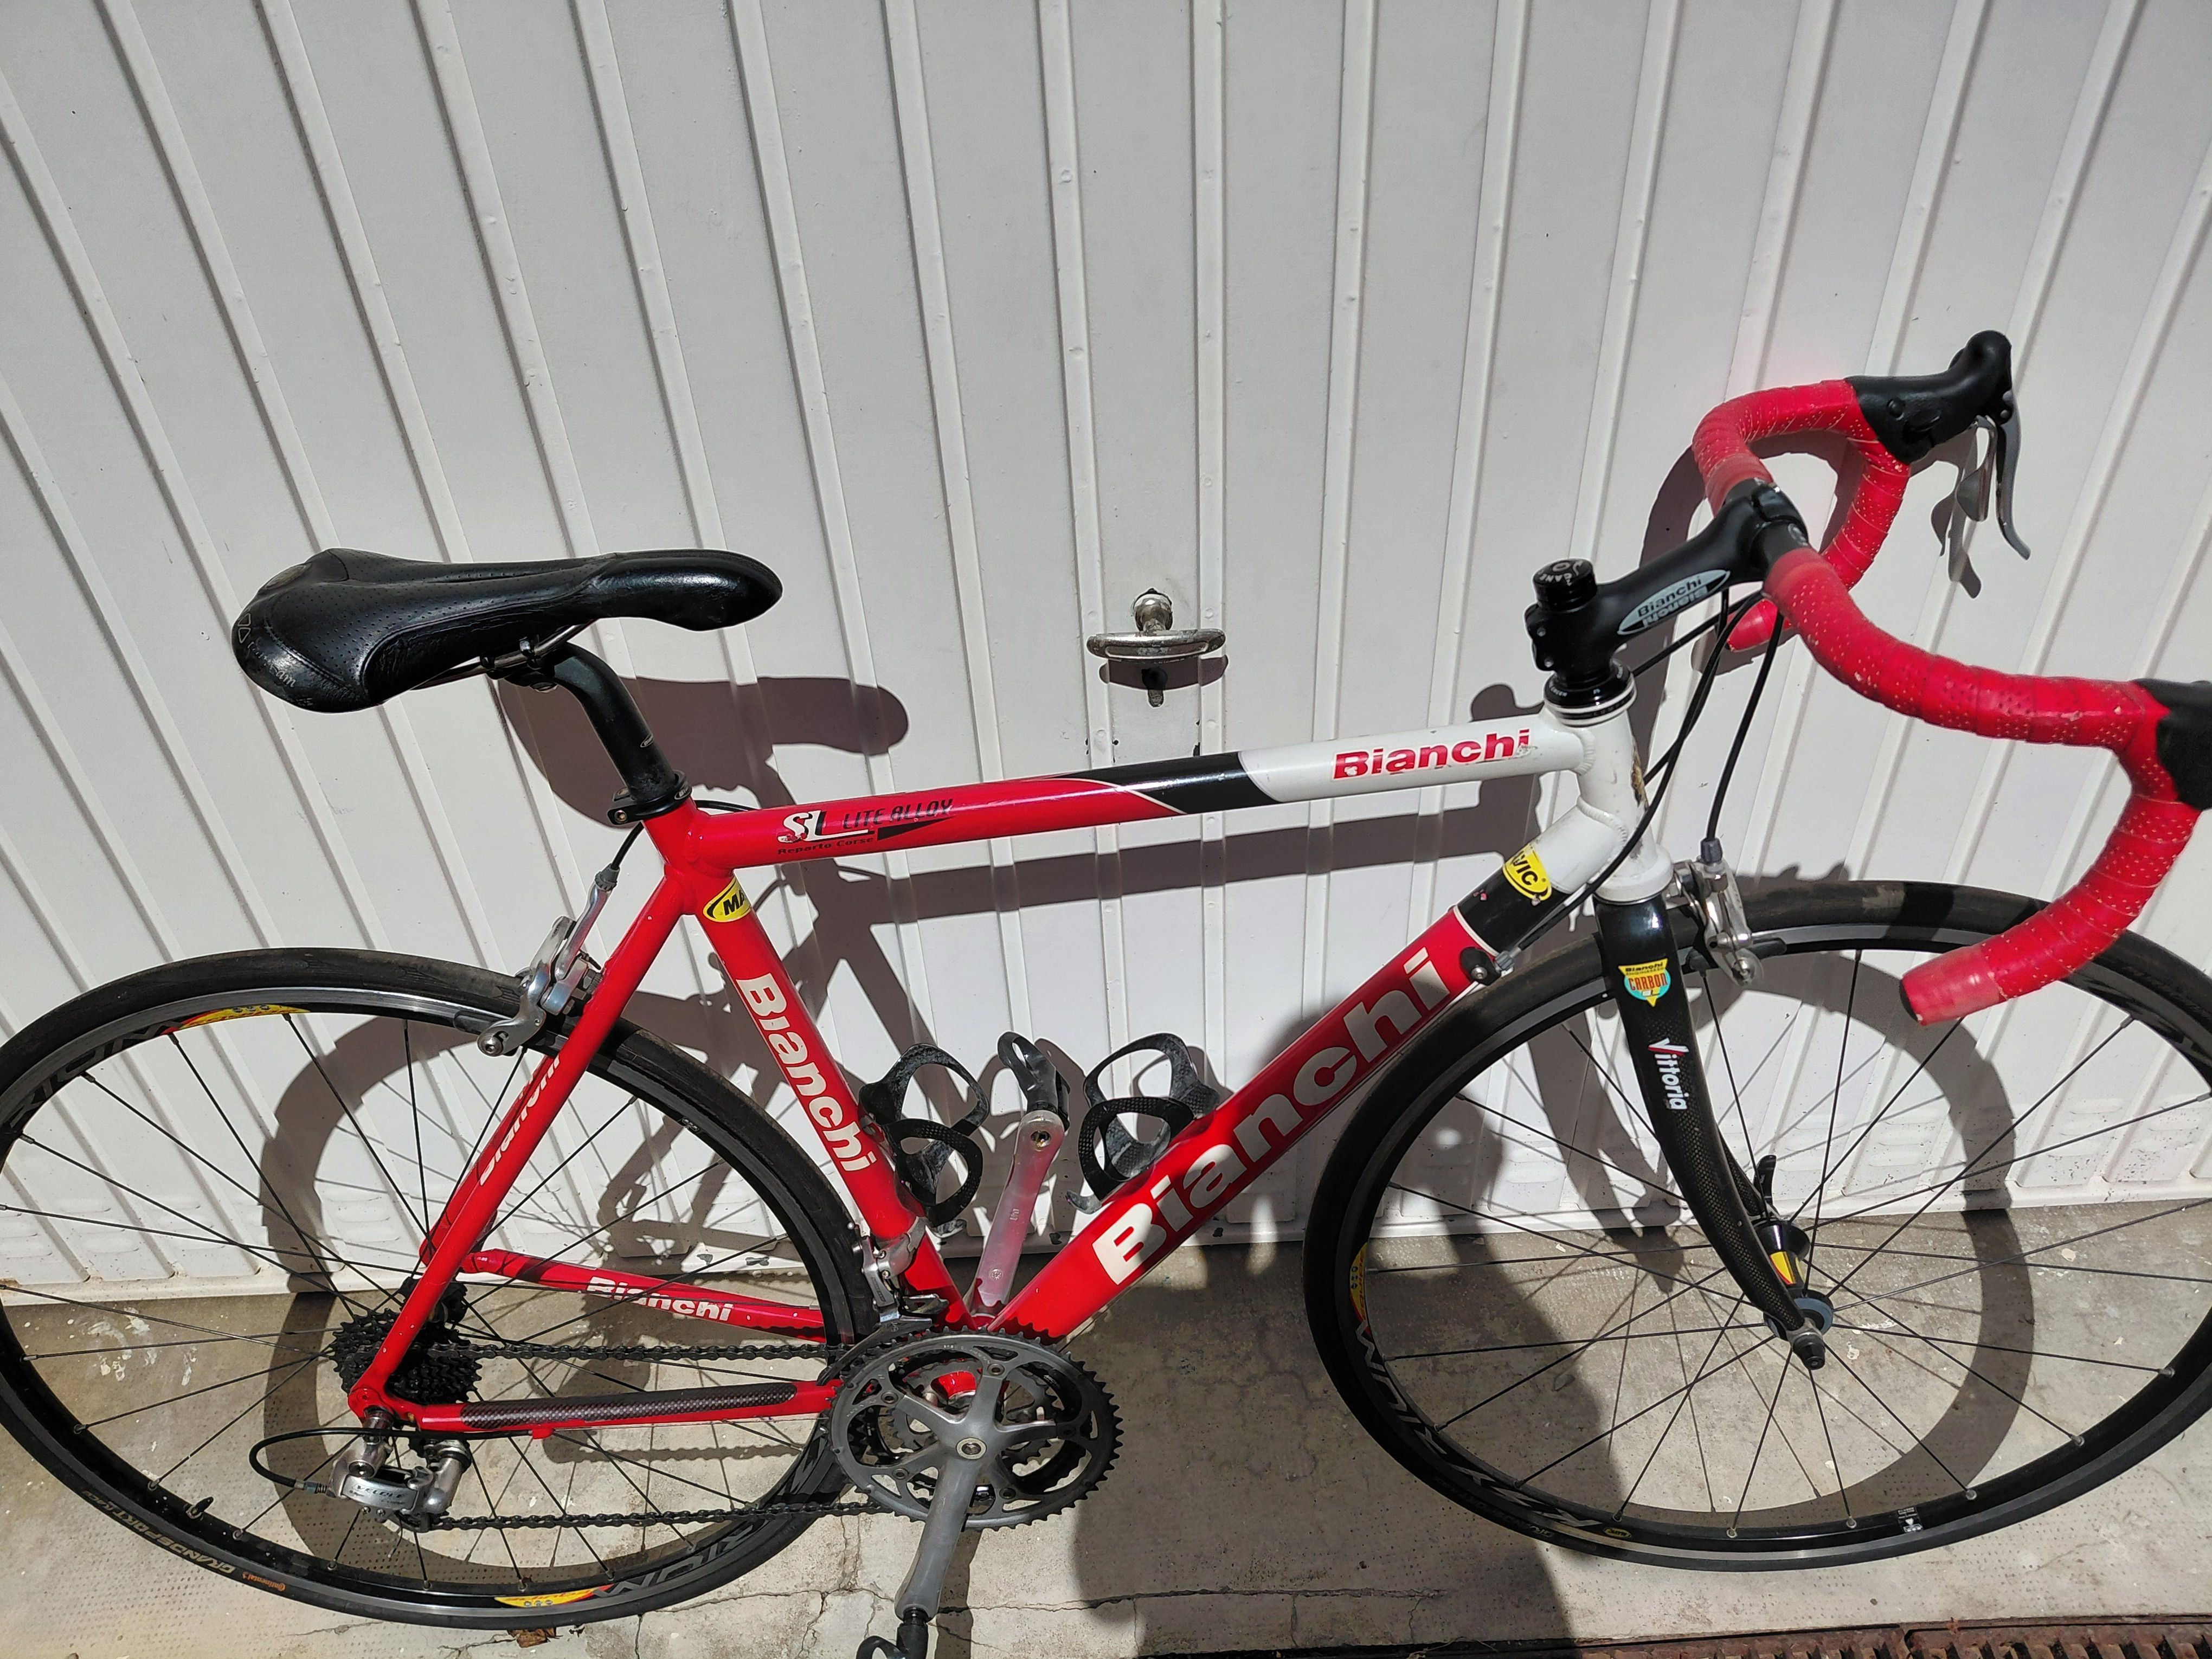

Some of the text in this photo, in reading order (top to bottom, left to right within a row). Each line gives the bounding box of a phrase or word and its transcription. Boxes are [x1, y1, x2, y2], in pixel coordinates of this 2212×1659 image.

[1637, 575, 1702, 618] Bianchi
[1332, 728, 1531, 780] Bianchi
[777, 798, 954, 843] SL LITE ALLOY
[777, 837, 877, 855] Reparto Corse
[735, 972, 872, 1172] Bianchi
[1648, 1037, 1689, 1110] Vittoria
[1091, 947, 1451, 1285] Bianchi
[586, 1276, 734, 1322] Bianchi
[247, 1573, 287, 1592] Continental
